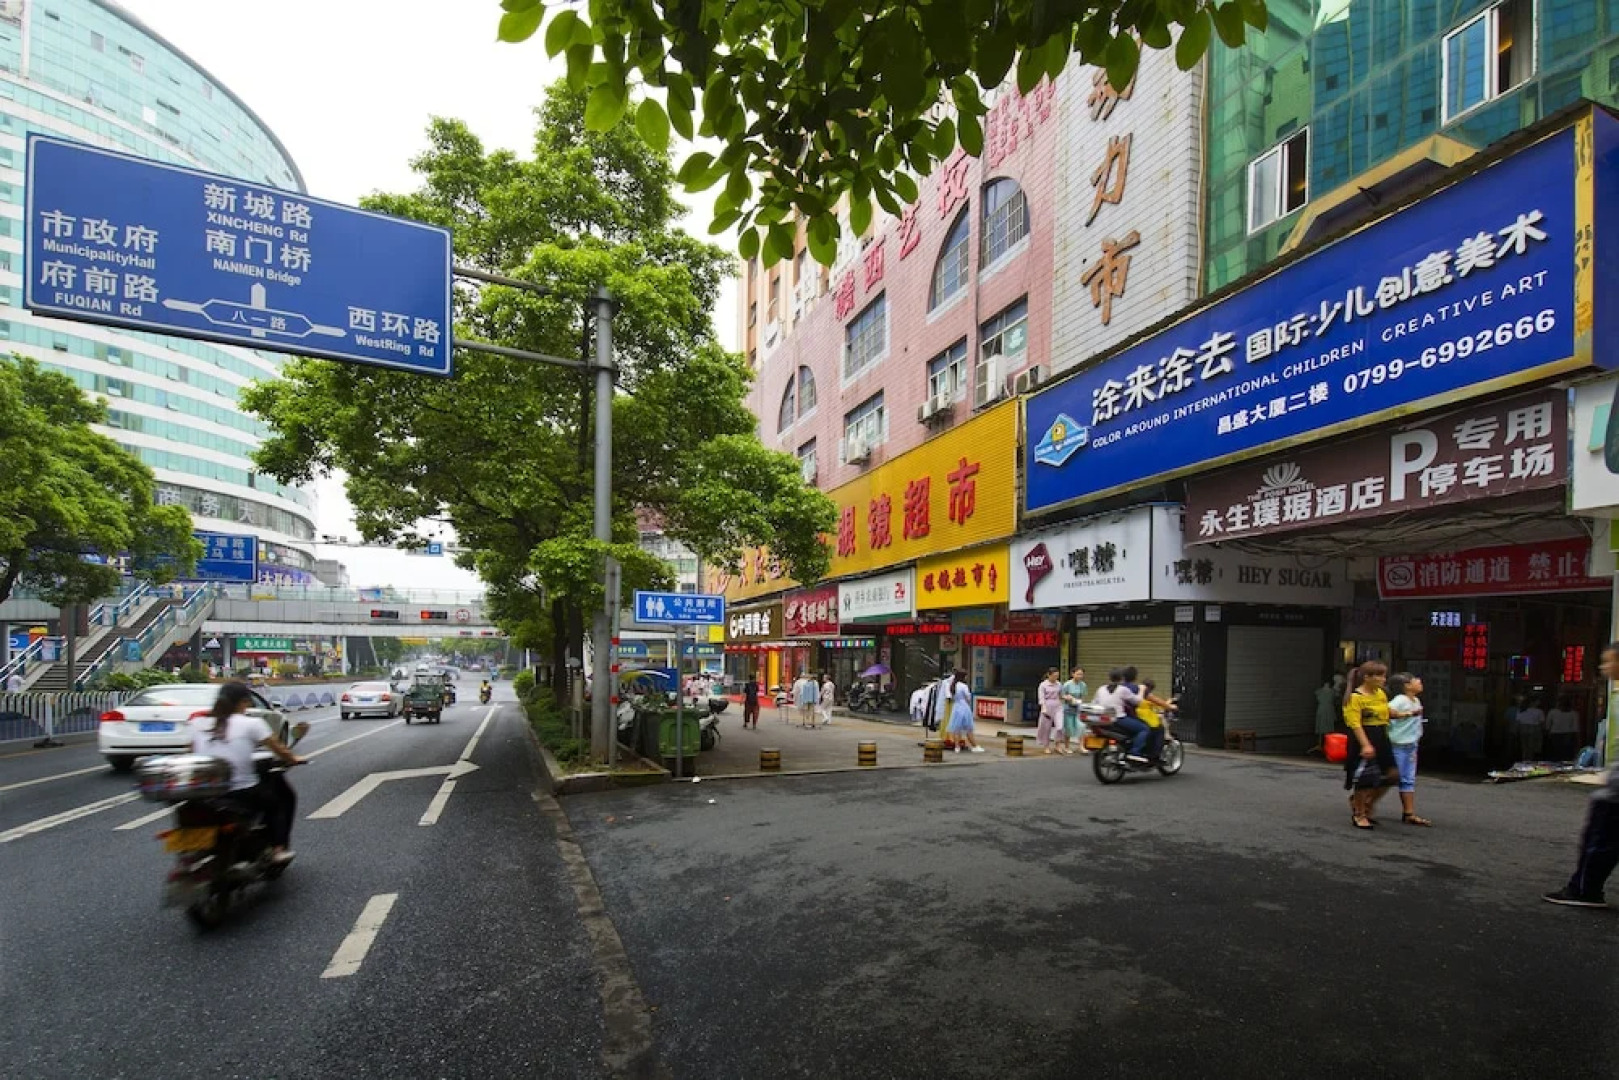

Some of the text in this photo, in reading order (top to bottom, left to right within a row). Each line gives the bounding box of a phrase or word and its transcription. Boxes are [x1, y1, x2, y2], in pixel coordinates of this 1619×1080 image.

[204, 182, 313, 230] 新城路
[206, 211, 309, 244] XINCHENG Rd
[40, 209, 158, 254] 市政府
[205, 228, 311, 273] 南门桥
[39, 259, 159, 304] 府前路
[213, 258, 302, 287] NANMEN Bridge
[54, 292, 142, 318] FUQIAN Rd
[231, 309, 287, 331] 八一路
[348, 305, 441, 344] 西环路
[1092, 331, 1236, 426] 涂来涂去
[1246, 208, 1549, 364] 国际少儿创意美术
[355, 334, 435, 358] WestRing Rd
[1092, 270, 1549, 449] COLOR AROUND INTERNATIONAL CHILDREN CREATIVE ART
[1217, 308, 1556, 435] 昌盛大厦二楼 0799-6992666
[1452, 402, 1553, 450] 专用
[1390, 428, 1439, 502] P
[1418, 443, 1555, 498] 停车场
[1238, 565, 1332, 588] HEY SUGAR
[1419, 555, 1511, 587] 消防通道
